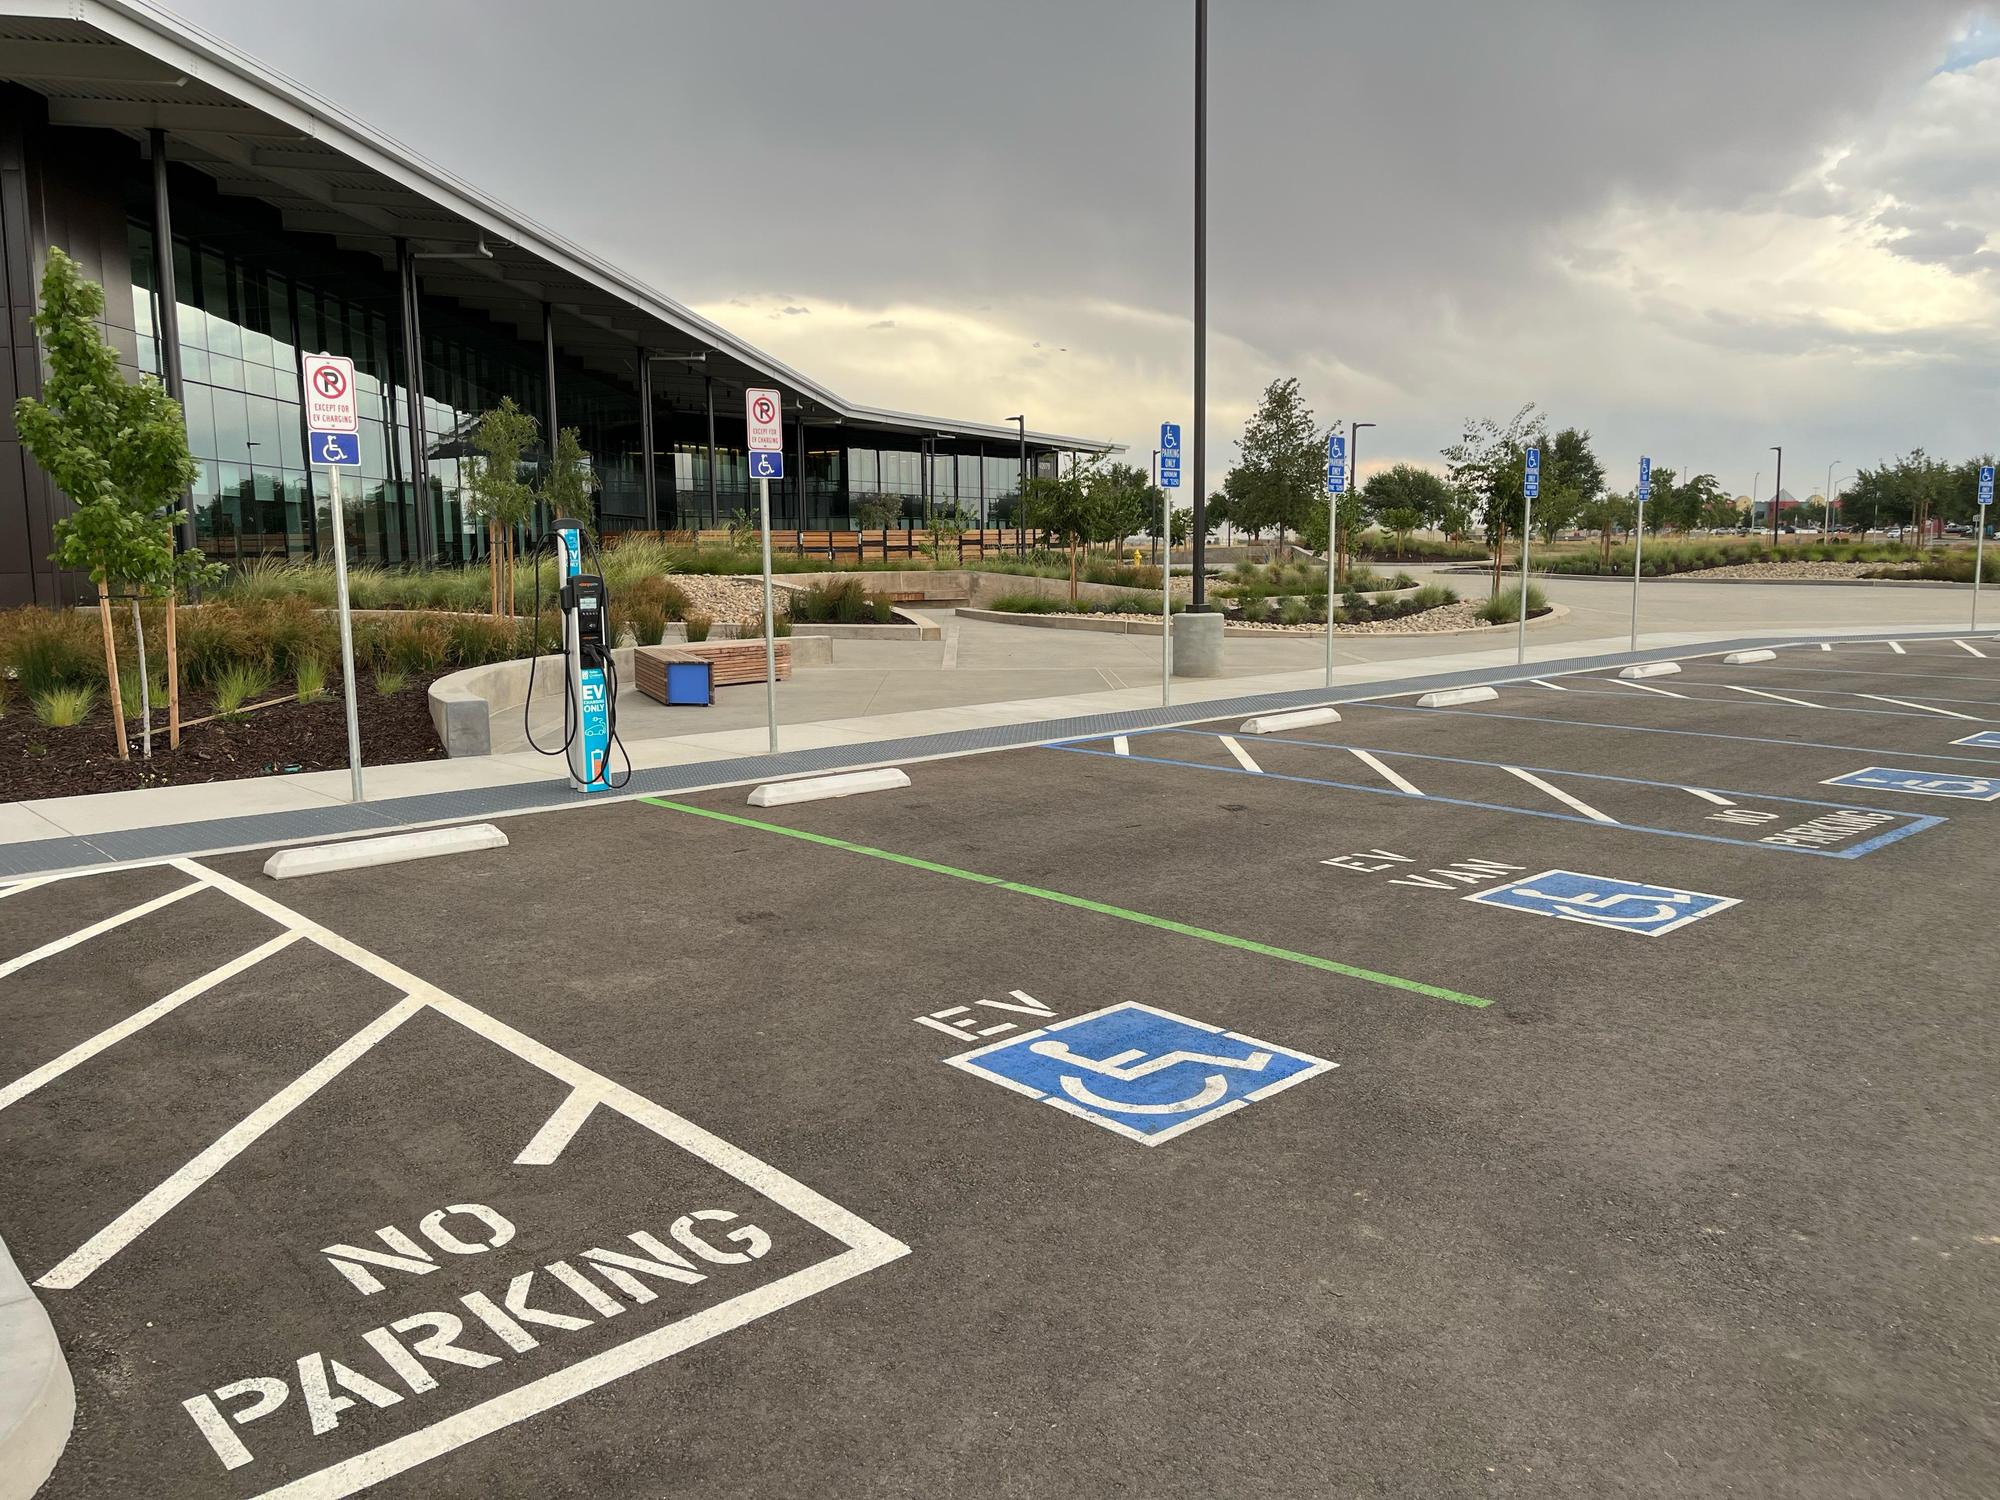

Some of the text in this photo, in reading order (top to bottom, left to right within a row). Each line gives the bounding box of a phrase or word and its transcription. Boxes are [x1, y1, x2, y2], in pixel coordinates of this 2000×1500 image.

[314, 403, 350, 413] EXCEPT FOR
[313, 414, 353, 424] EV CHARGING
[1161, 449, 1180, 458] PARKING
[1165, 458, 1176, 468] ONLY
[582, 684, 604, 700] EV
[583, 704, 605, 713] ONLY
[1704, 809, 1780, 826] NO
[1758, 810, 1896, 849] PARKING
[1319, 848, 1417, 873] EV
[1387, 858, 1528, 890] VAN
[912, 989, 1060, 1042] EV
[320, 1203, 516, 1296] NO
[182, 1209, 773, 1471] PARKING
